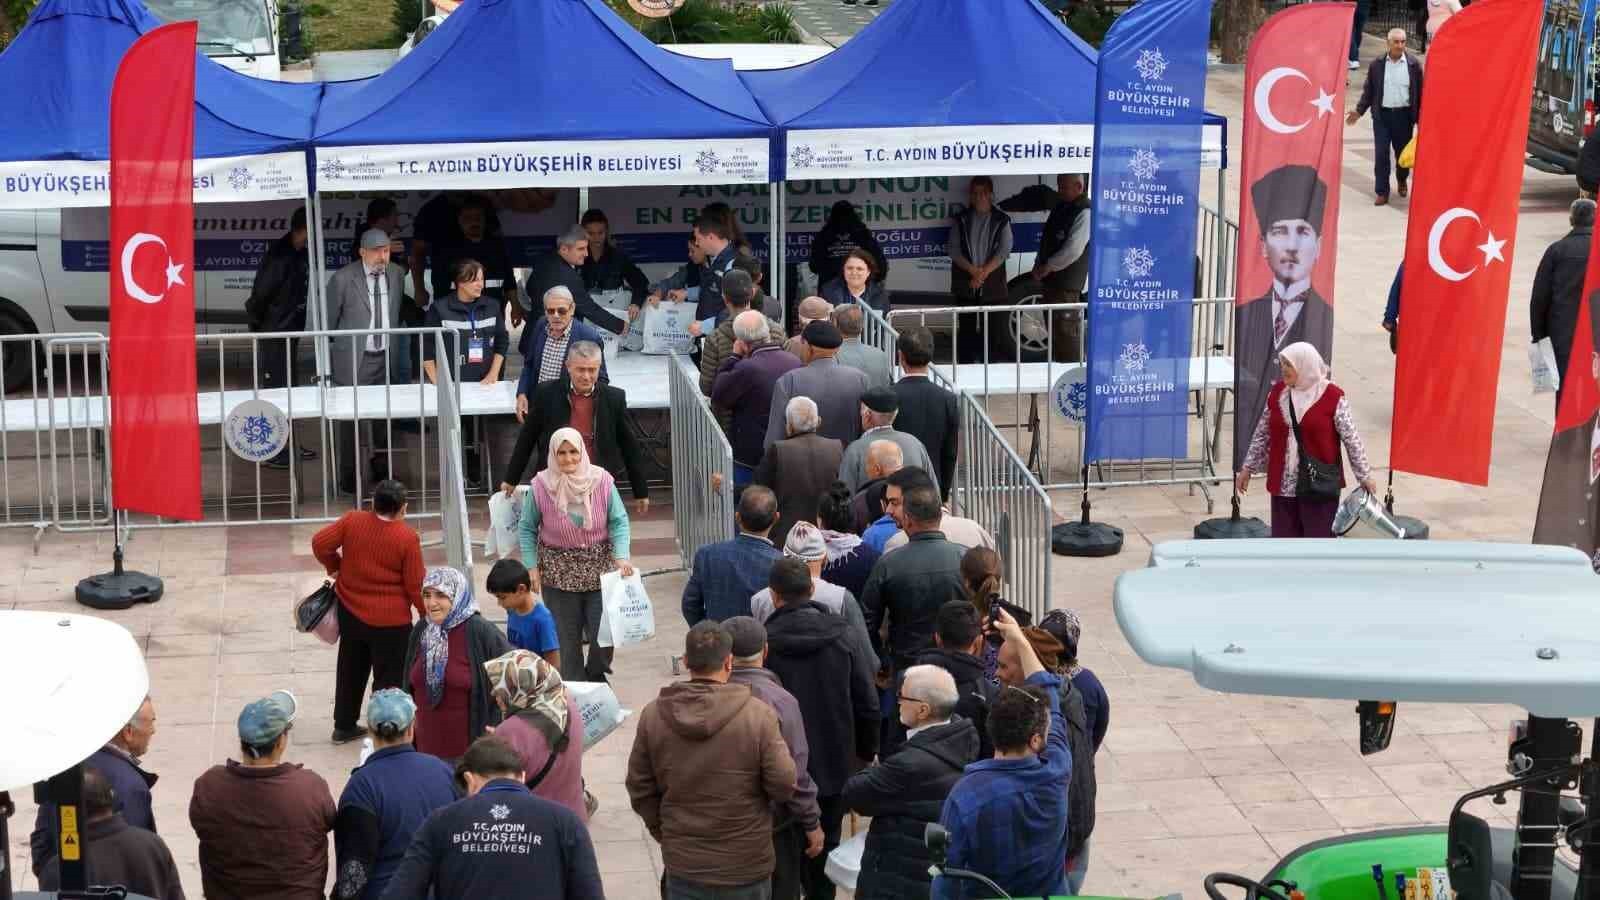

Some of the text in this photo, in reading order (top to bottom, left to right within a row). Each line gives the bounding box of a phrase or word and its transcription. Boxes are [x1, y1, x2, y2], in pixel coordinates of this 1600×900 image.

[1144, 85, 1173, 93] AYDIN
[1107, 90, 1191, 108] BÜYÜKŞEHİR
[1122, 105, 1175, 118] BELEDİYESİ
[864, 141, 1091, 162] T.C. AYDIN BÜYÜKŞEHİR BELE
[397, 153, 681, 176] T.C. AYDIN BÜYÜKŞEHİR BELEDİYESİ
[1139, 184, 1167, 192] AYDIN
[1103, 189, 1184, 205] BÜYÜKŞEHİR
[635, 207, 672, 224] EN
[1118, 204, 1169, 215] BELEDİYESİ
[1134, 280, 1162, 288] AYDIN
[1098, 288, 1179, 302] BÜYÜKŞEHİR
[1111, 301, 1164, 311] BELEDİYESİ
[1096, 383, 1174, 395] BÜYÜKŞEHİR
[1108, 394, 1160, 404] BELEDİYESİ
[472, 822, 525, 833] T.C. AYDIN
[452, 831, 542, 846] BÜYÜKŞEHİR
[462, 843, 530, 854] BELEDİYESİ
